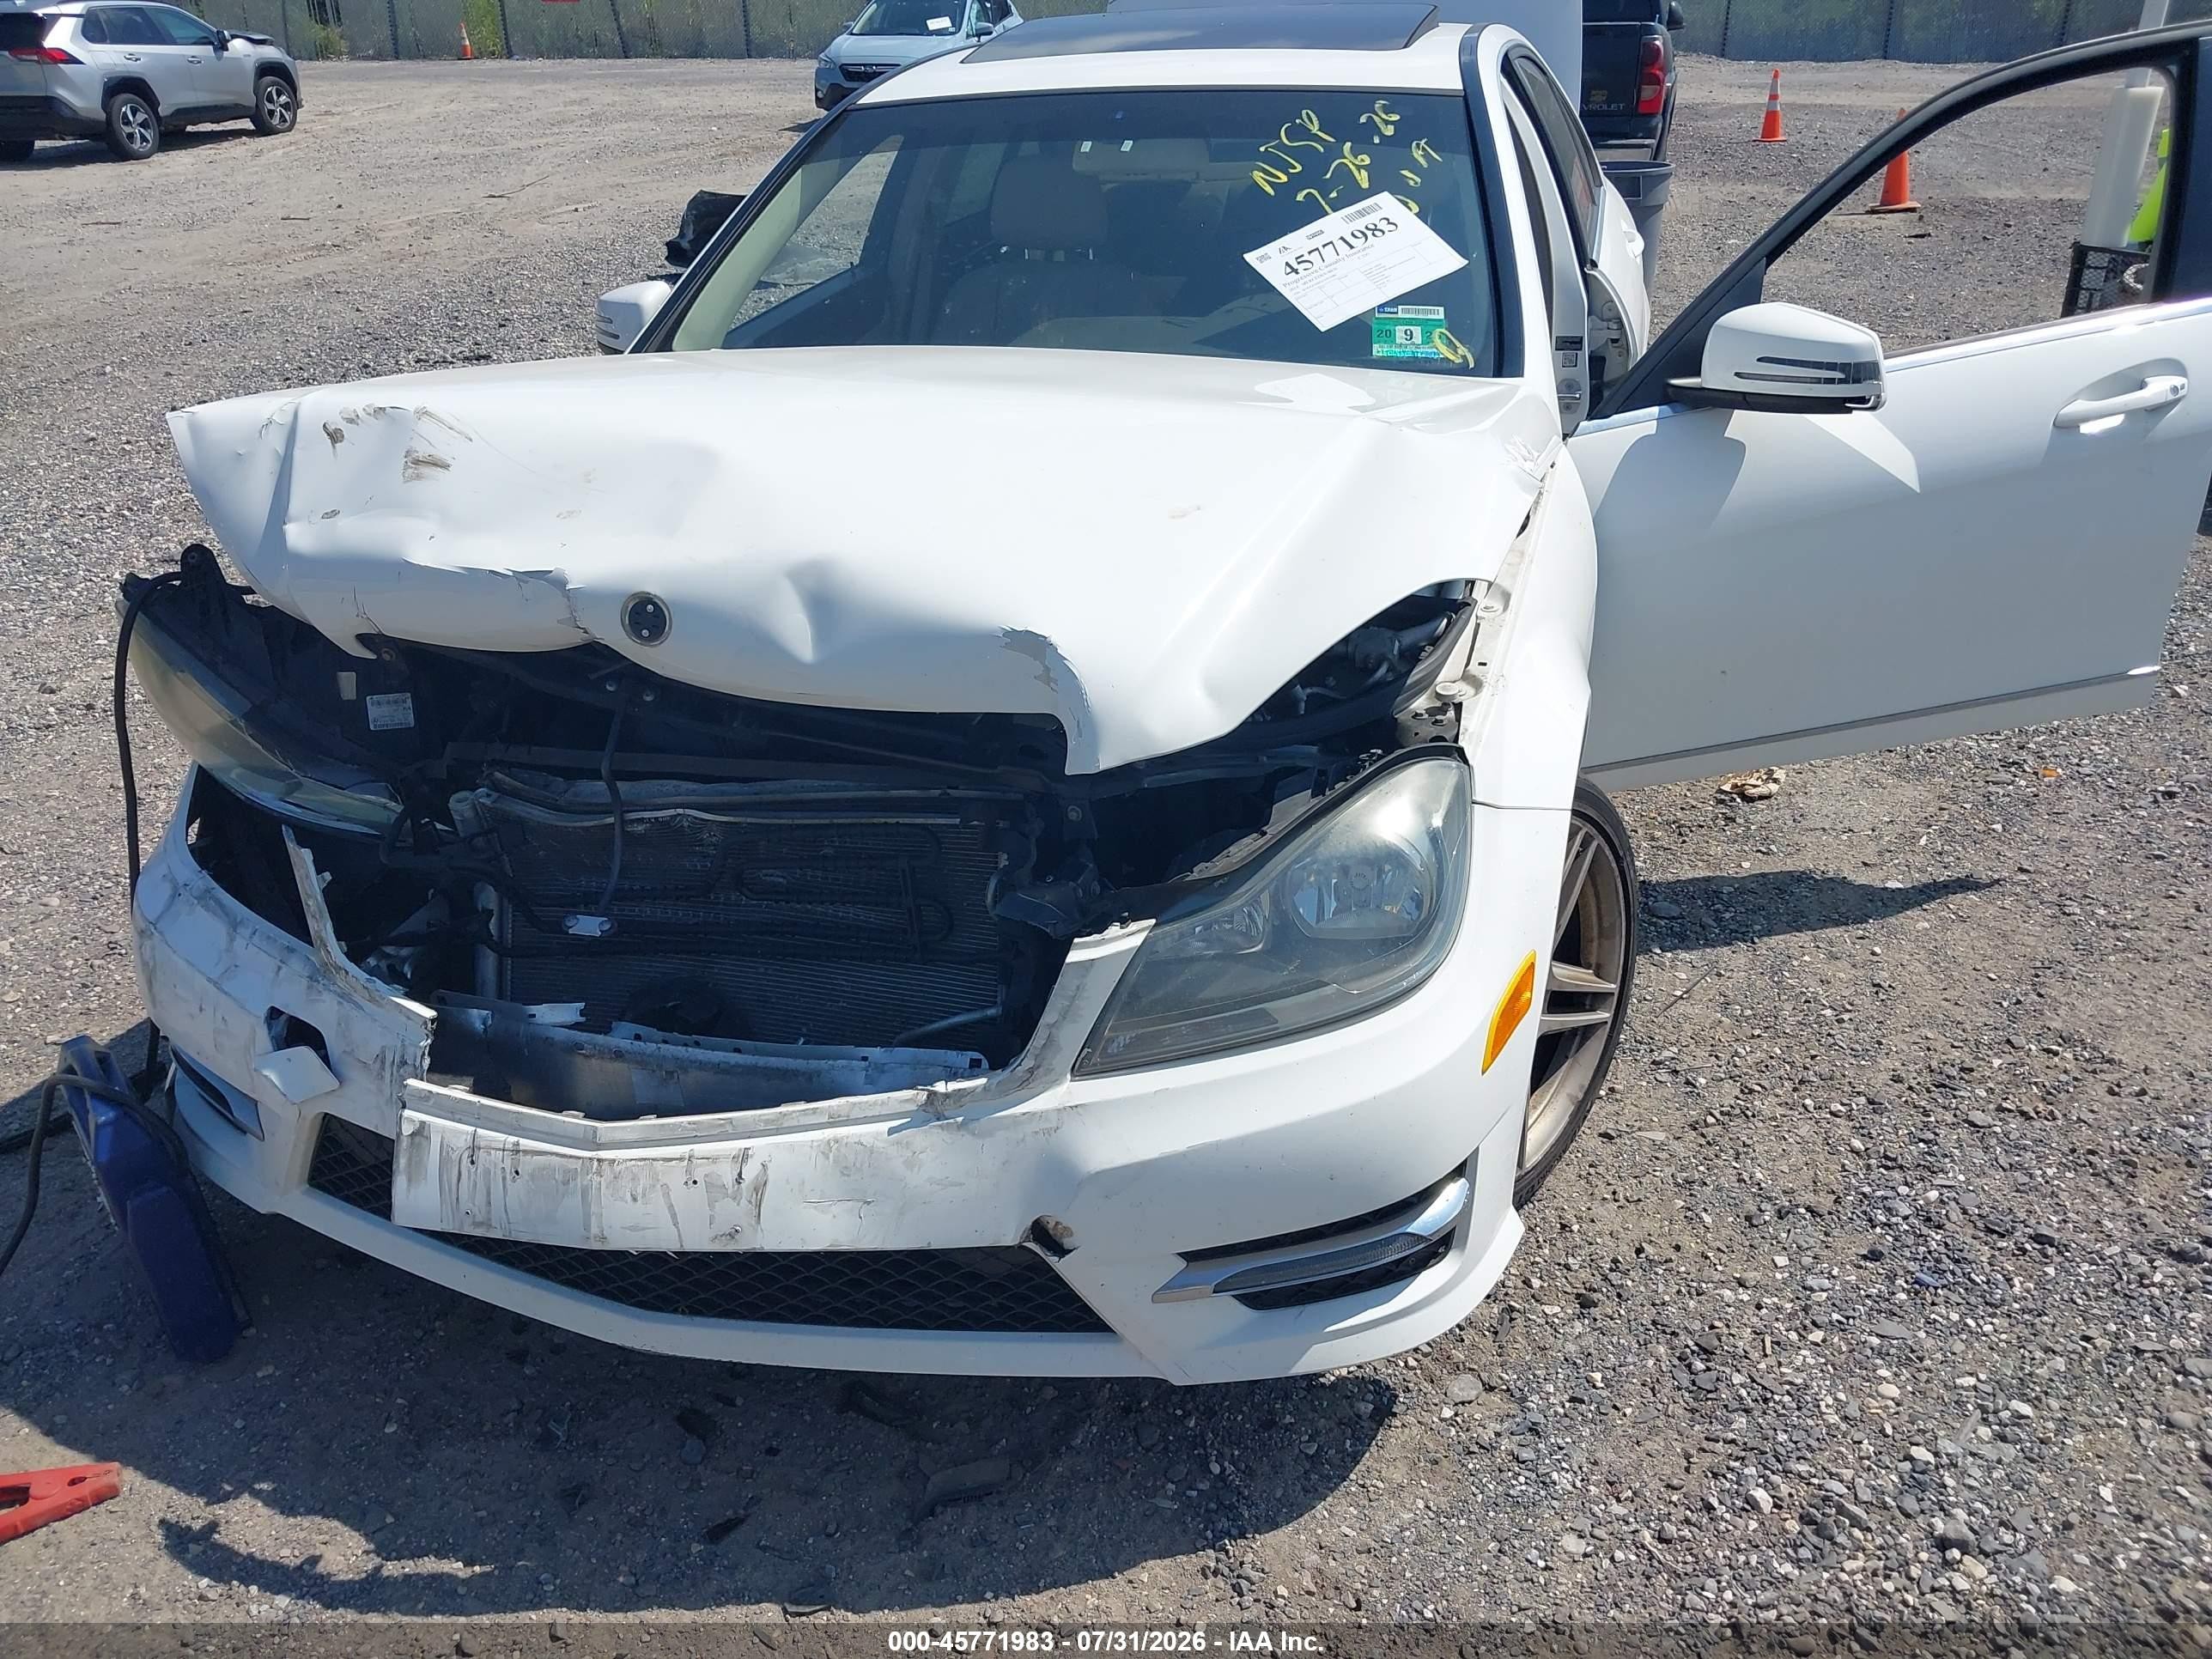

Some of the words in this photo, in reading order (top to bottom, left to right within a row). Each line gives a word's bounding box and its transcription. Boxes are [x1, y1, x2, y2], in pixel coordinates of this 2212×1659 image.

[1284, 216, 1399, 276] 45771983
[1376, 329, 1392, 338] 20
[1403, 328, 1414, 342] 9
